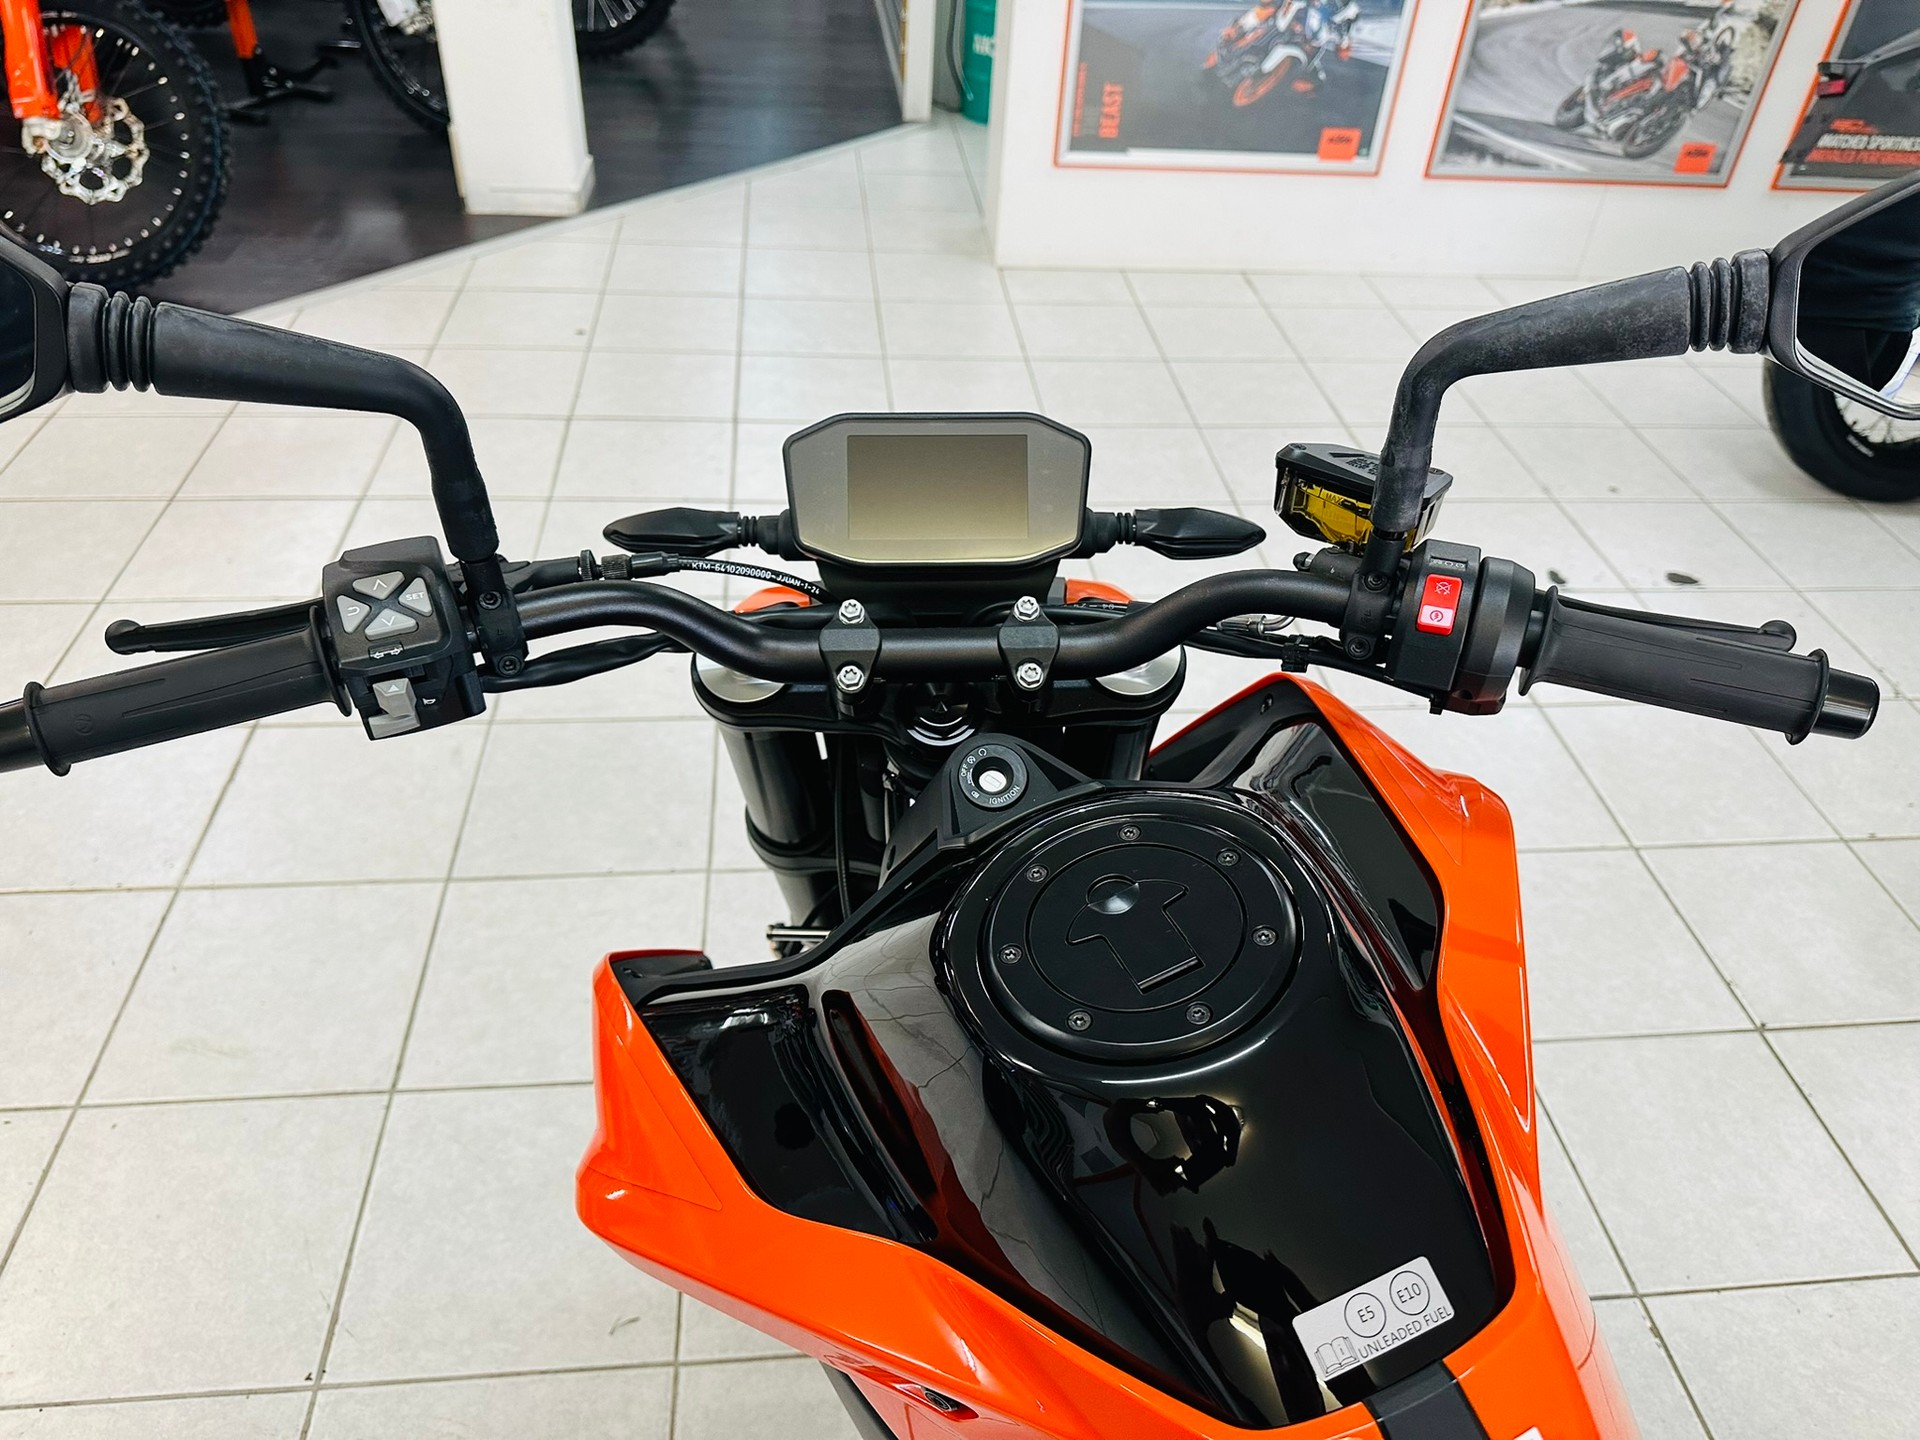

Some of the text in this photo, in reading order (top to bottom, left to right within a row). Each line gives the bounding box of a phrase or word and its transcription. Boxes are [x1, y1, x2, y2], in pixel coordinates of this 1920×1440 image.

[405, 591, 425, 600] SET
[989, 784, 1020, 804] IGNITION
[1396, 1282, 1422, 1304] E10
[1357, 1305, 1375, 1323] E5
[1358, 1305, 1451, 1359] UNLEADED FUEL
